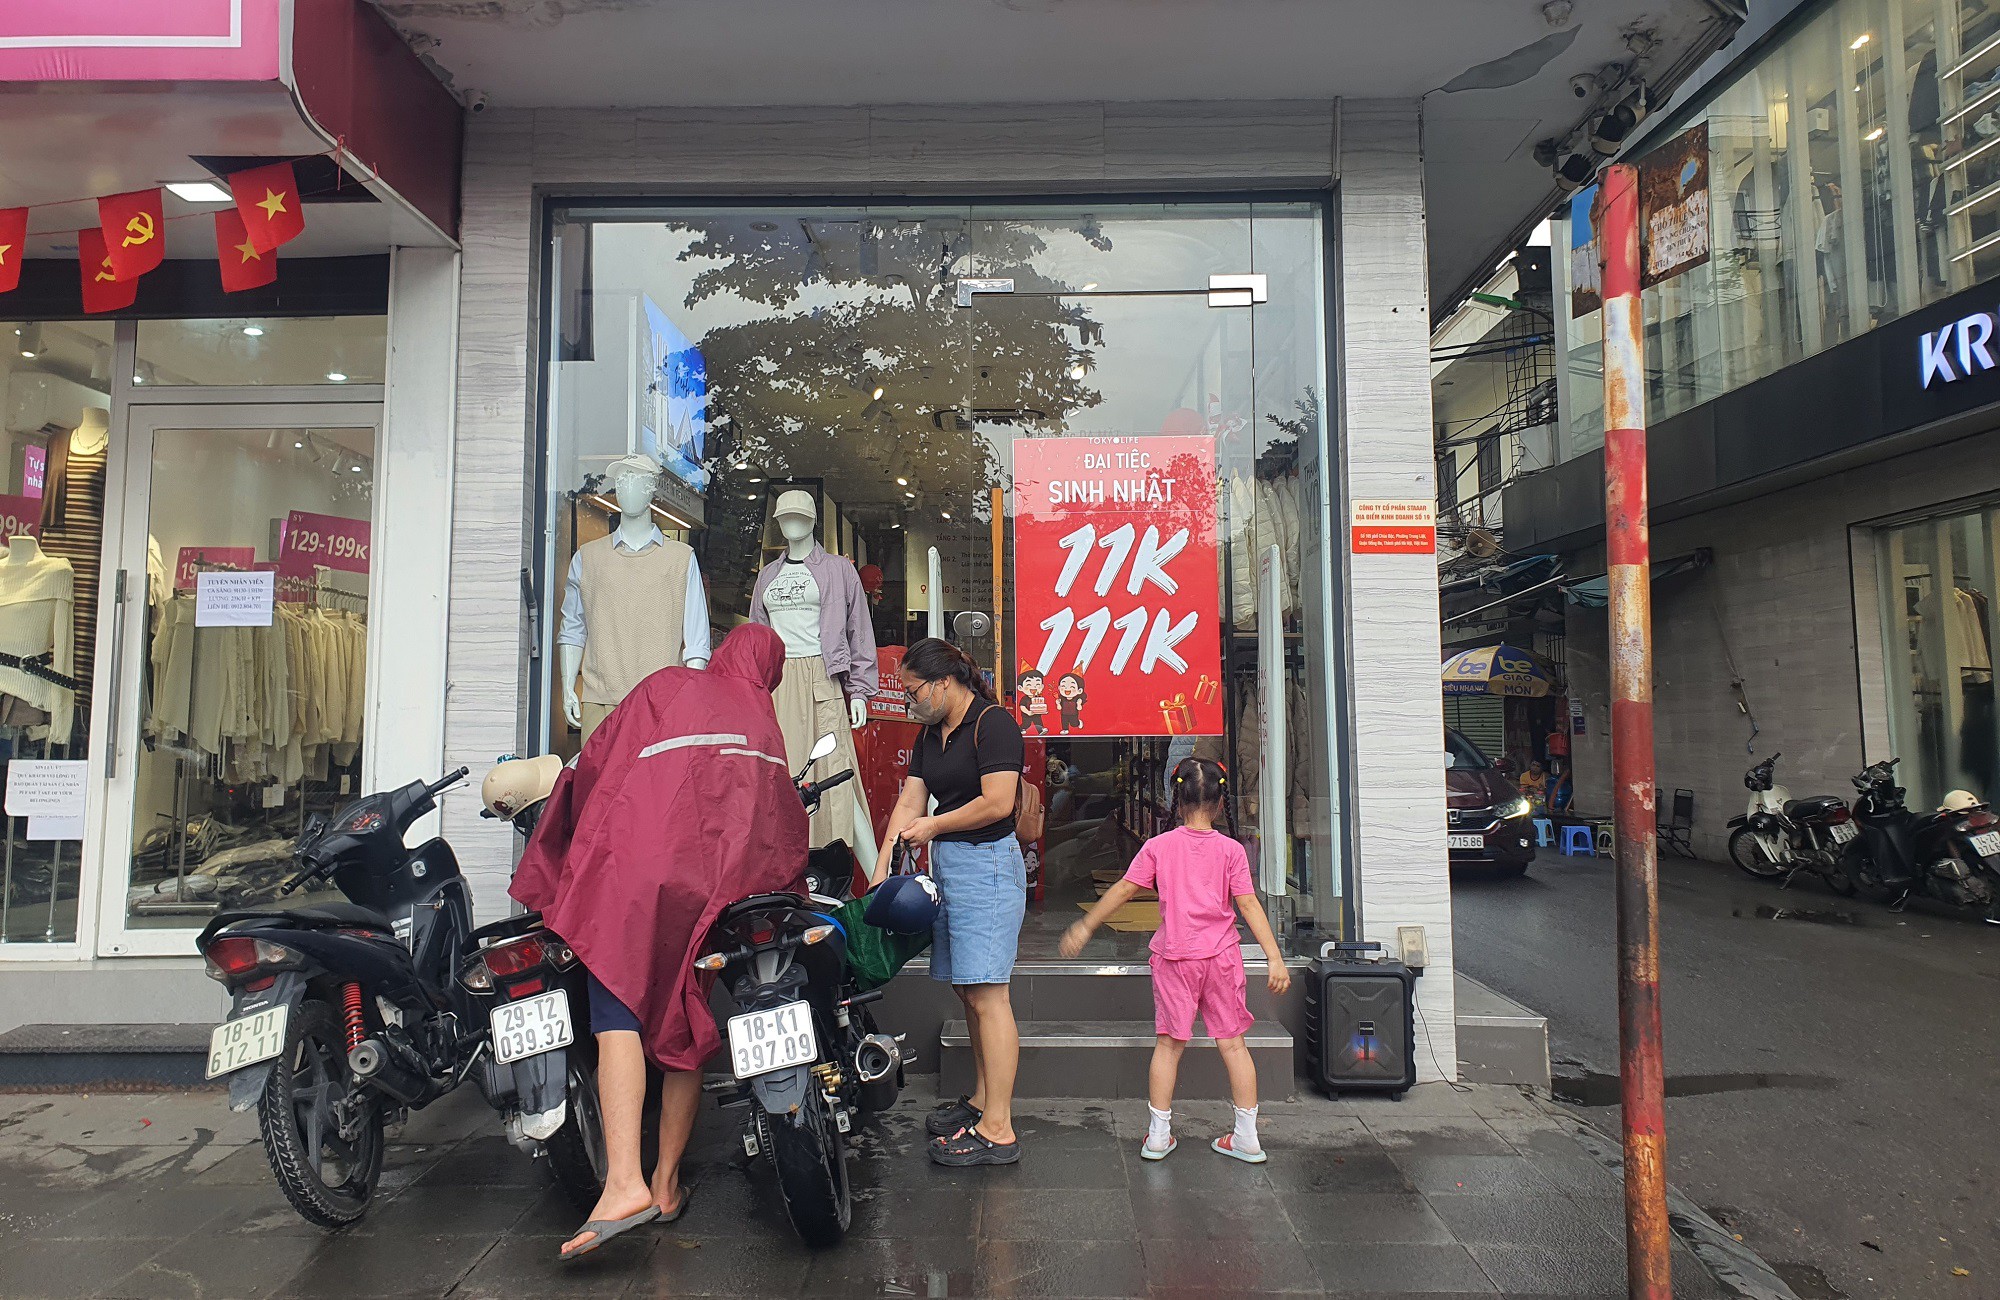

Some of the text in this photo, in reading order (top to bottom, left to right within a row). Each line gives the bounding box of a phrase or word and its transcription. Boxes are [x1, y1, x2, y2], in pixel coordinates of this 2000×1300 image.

[28, 456, 39, 472] Tự
[1084, 448, 1151, 474] ĐẠI TIỆC
[1049, 473, 1176, 508] SINH NHẬT
[1054, 522, 1190, 598] 11K
[1036, 606, 1199, 676] 111K
[1457, 658, 1487, 675] be
[1498, 655, 1533, 673] be
[1502, 674, 1532, 682] GIAO
[243, 1000, 269, 1011] HONDA
[503, 997, 557, 1032] 29-T2
[224, 1011, 275, 1046] 18-D1
[501, 1019, 567, 1058] 039.32
[743, 1008, 798, 1042] 18-K1
[211, 1031, 278, 1073] 612.11
[738, 1033, 811, 1072] 397.09
